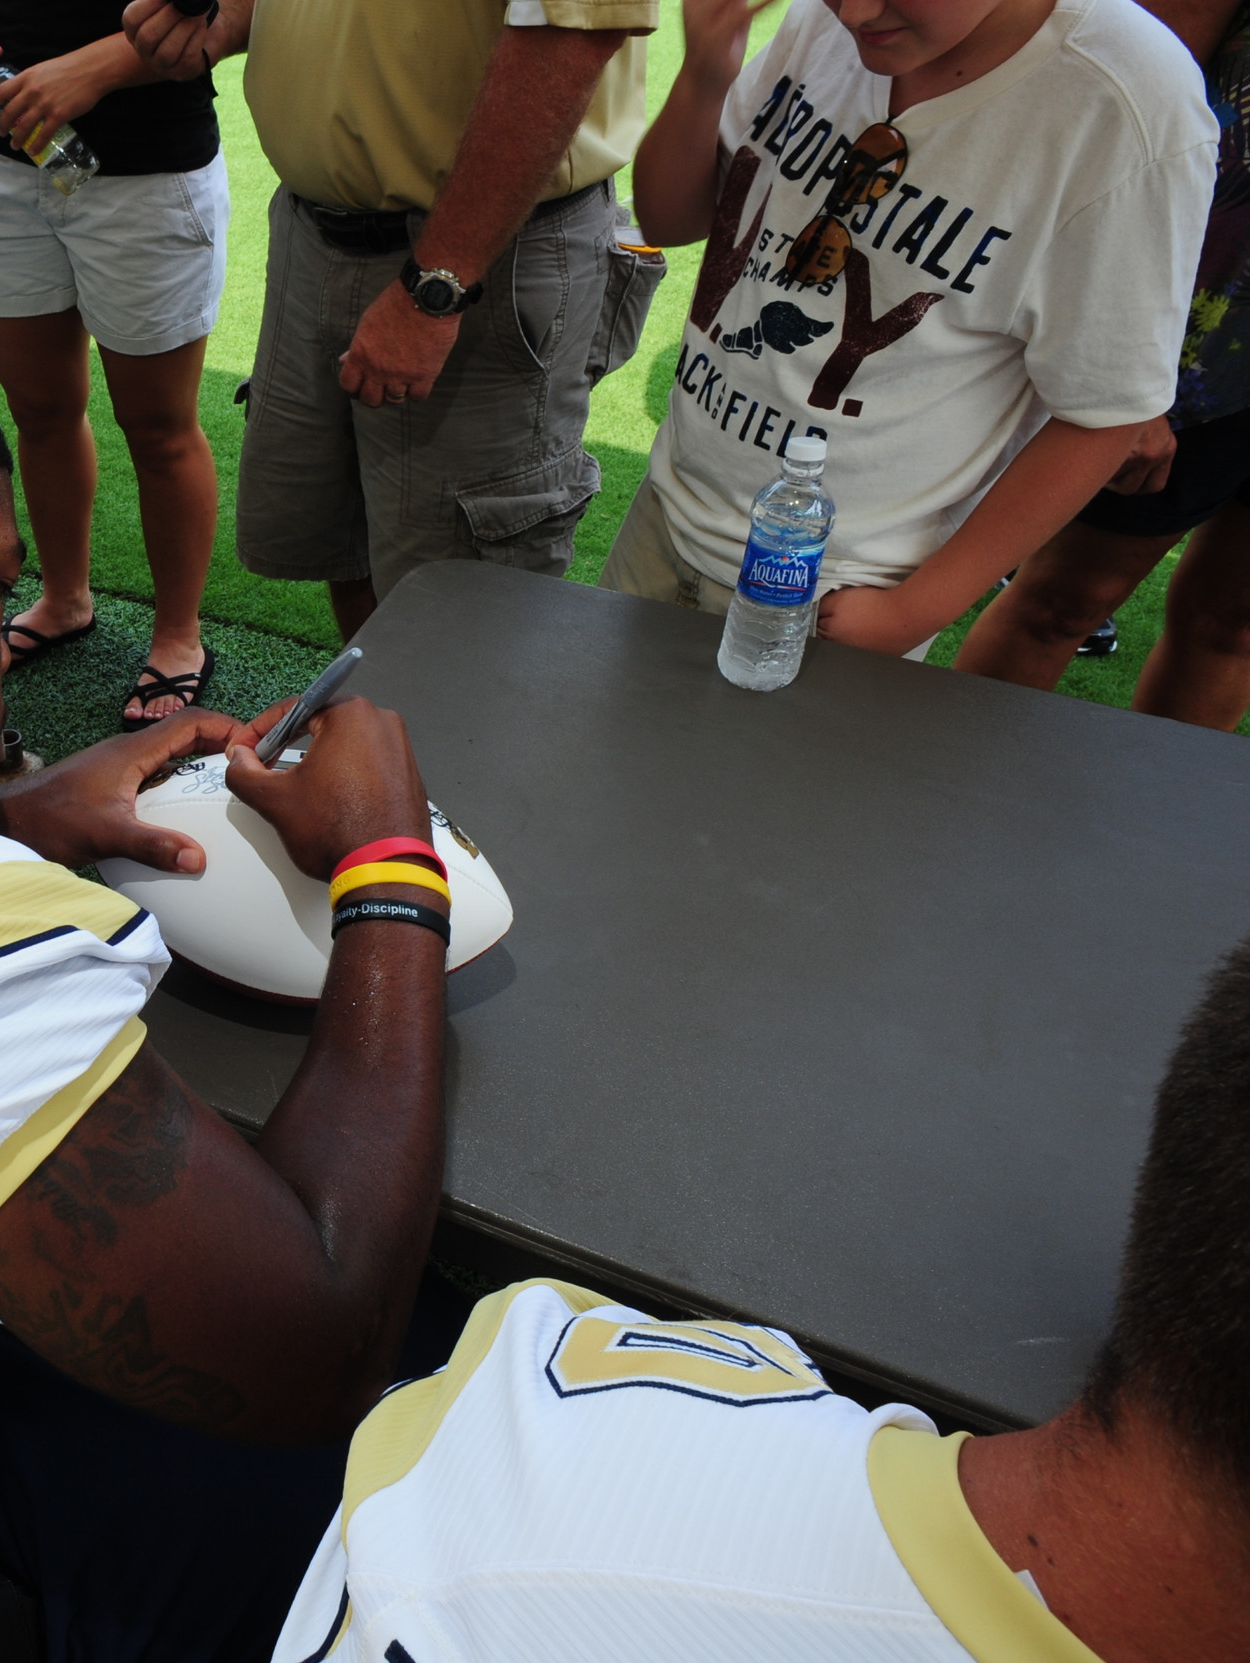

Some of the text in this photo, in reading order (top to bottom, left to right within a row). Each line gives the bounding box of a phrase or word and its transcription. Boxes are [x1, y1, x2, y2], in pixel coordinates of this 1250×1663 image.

[758, 228, 838, 269] STAE
[742, 256, 839, 297] CHAMPS
[675, 343, 723, 412] ACK
[748, 559, 809, 589] AQUAFINA
